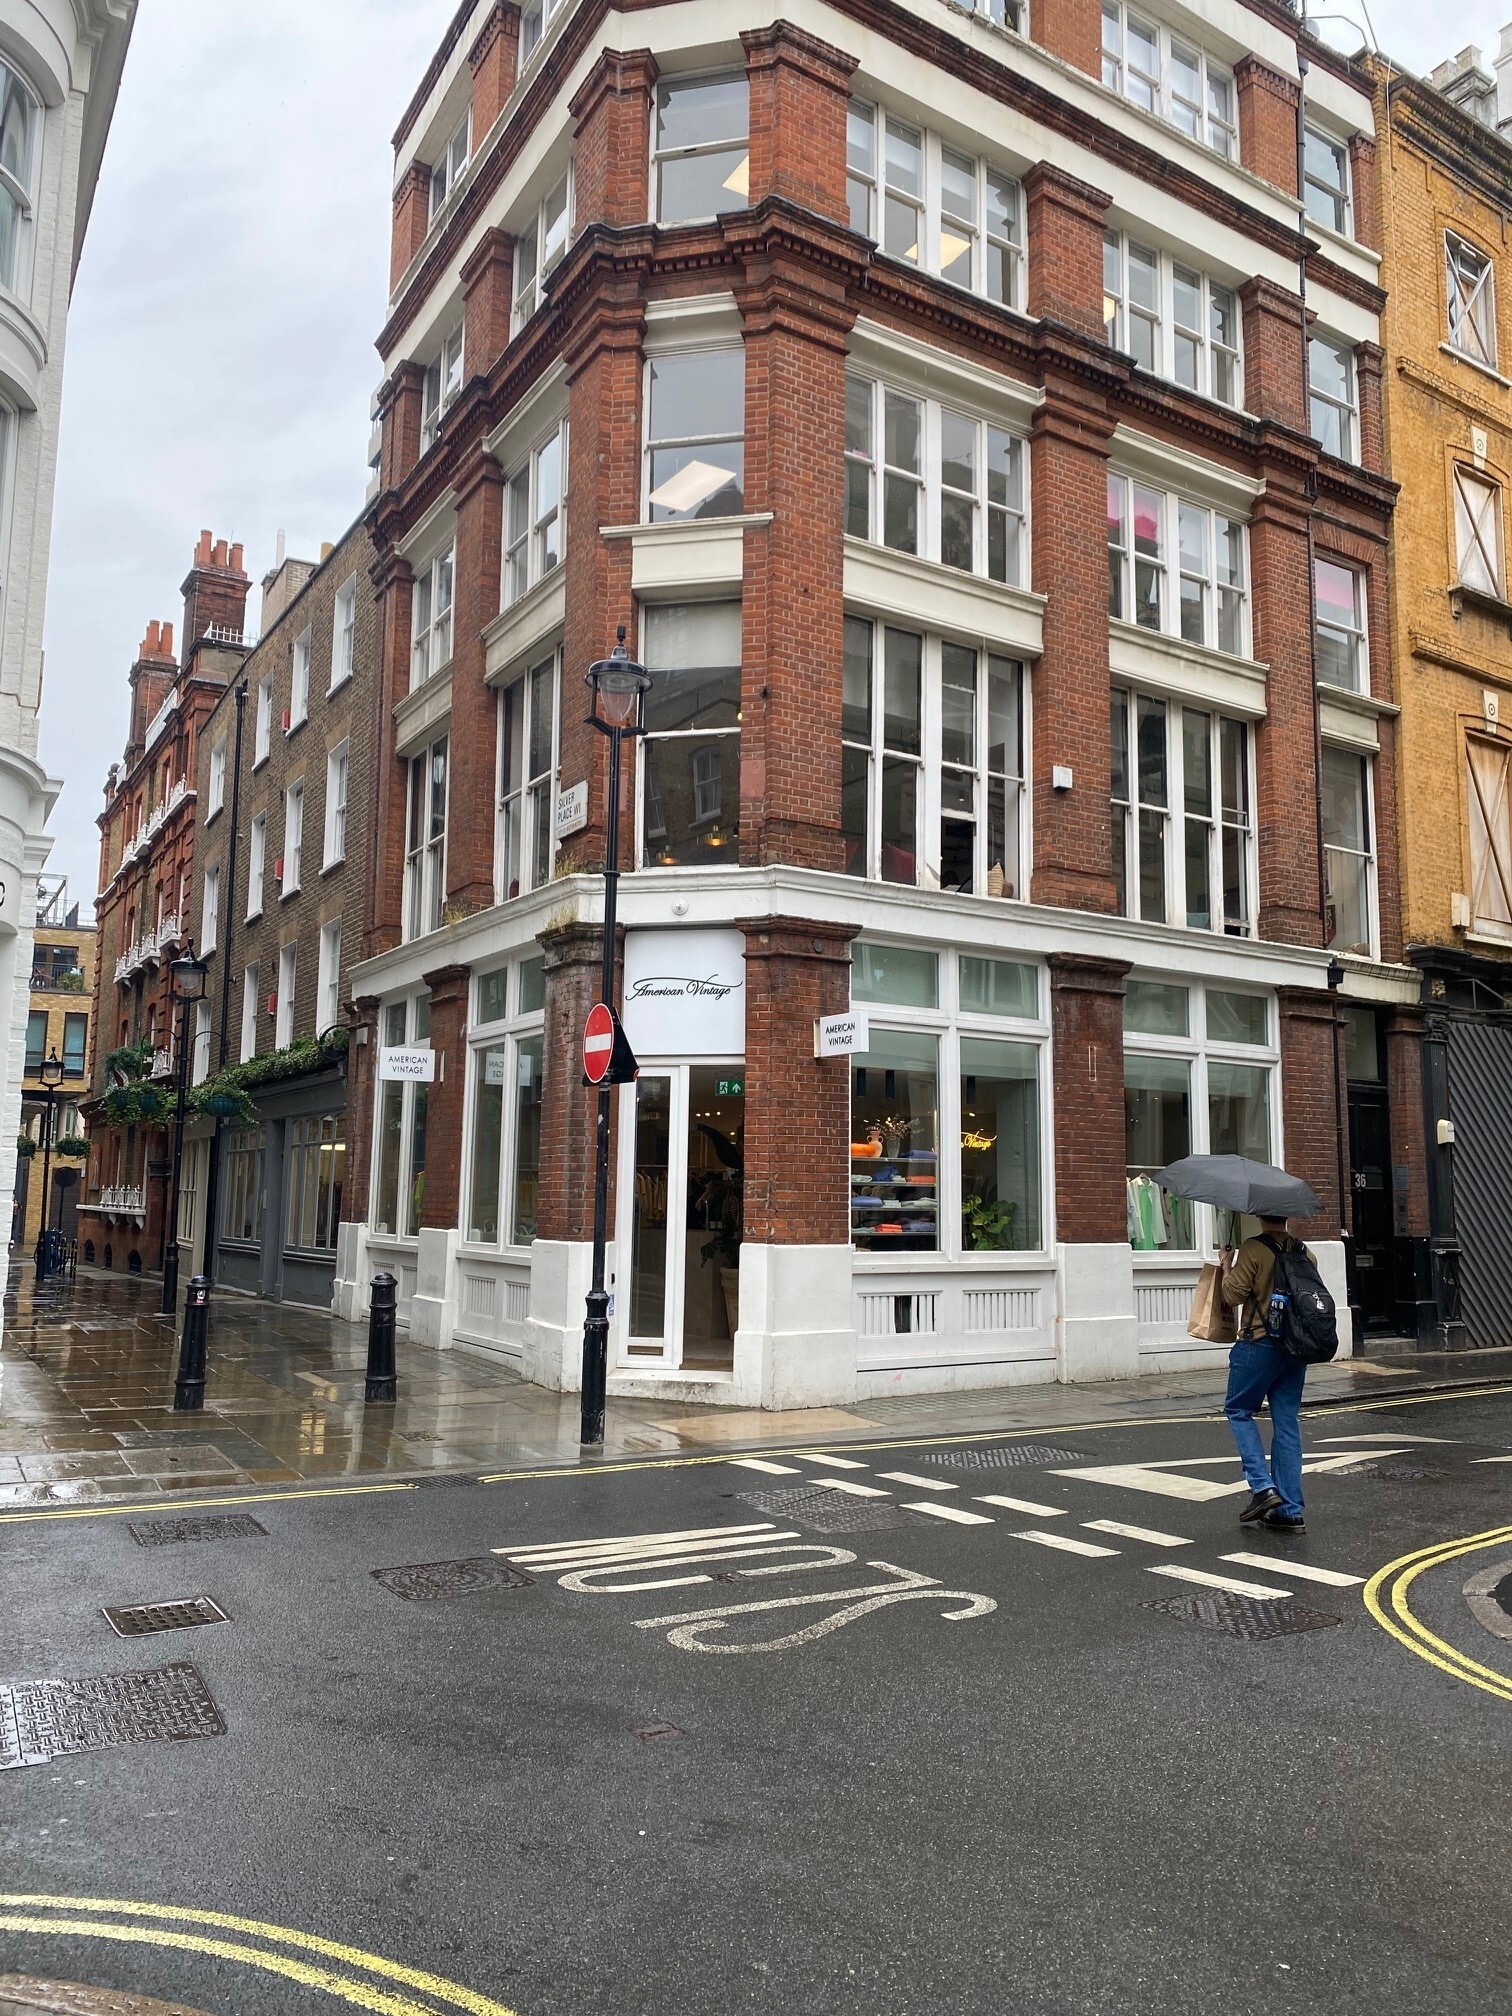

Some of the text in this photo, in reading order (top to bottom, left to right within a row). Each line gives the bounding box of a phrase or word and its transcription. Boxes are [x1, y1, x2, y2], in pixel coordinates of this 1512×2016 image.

[558, 791, 575, 810] SILVER
[557, 802, 581, 824] PLACE W1
[625, 974, 733, 1001] American Vintage
[825, 1021, 856, 1035] AMERICAN
[828, 1034, 853, 1046] VINTAGE
[388, 1055, 428, 1064] AMERICAN
[392, 1065, 424, 1075] VINTAGE
[1354, 1173, 1367, 1188] 36
[490, 1523, 998, 1654] SLOW
